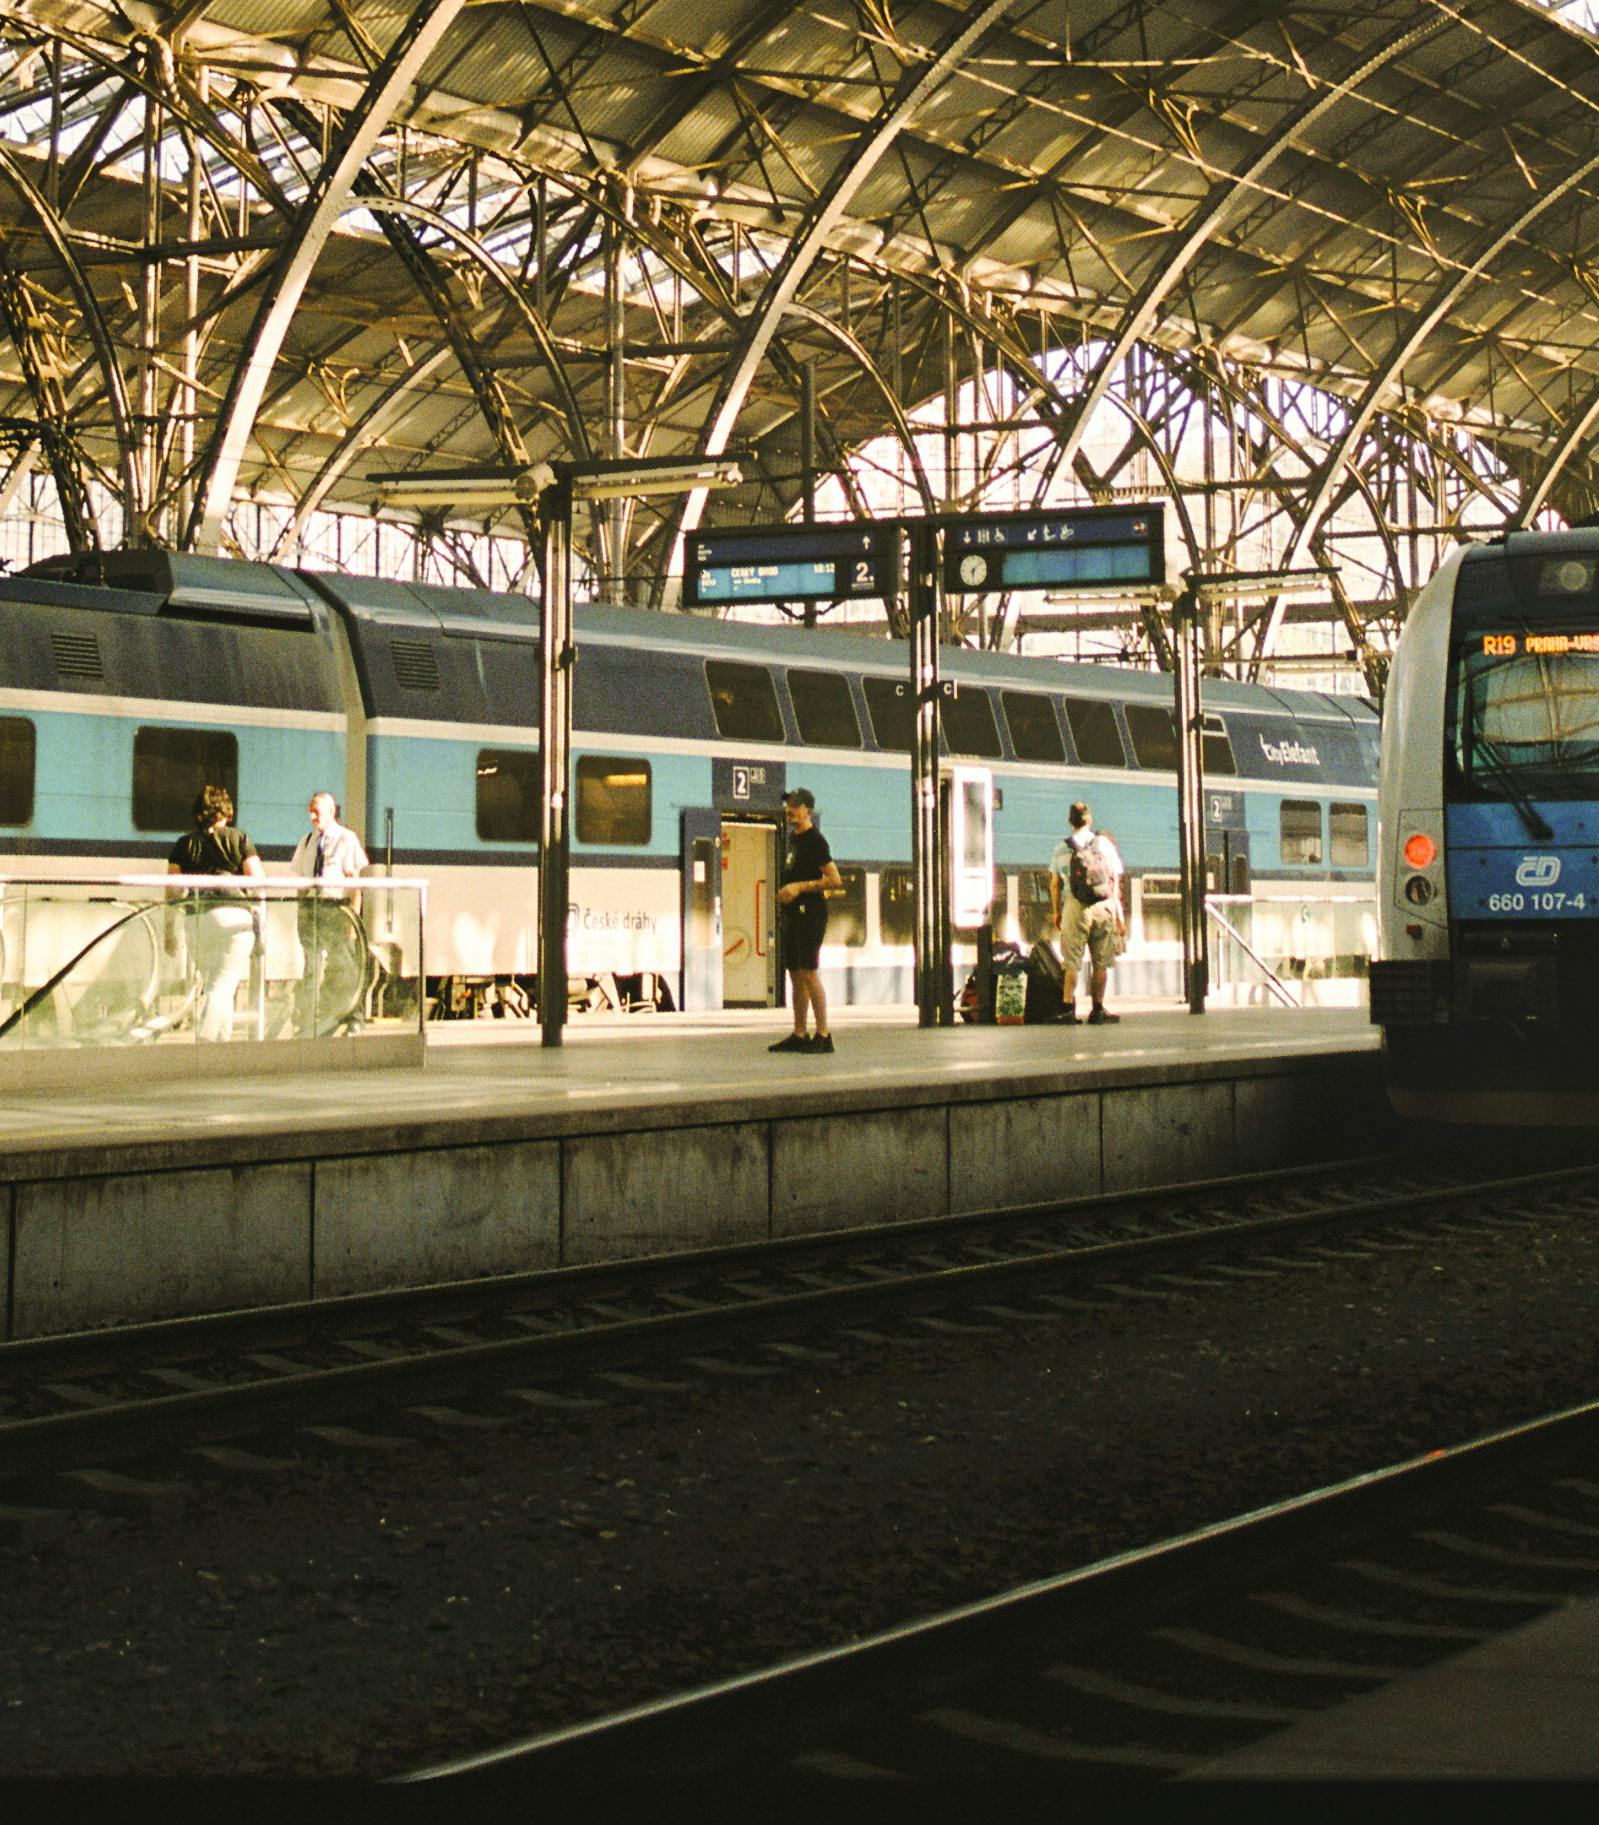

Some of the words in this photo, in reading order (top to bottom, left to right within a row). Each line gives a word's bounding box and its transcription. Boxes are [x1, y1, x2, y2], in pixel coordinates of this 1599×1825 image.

[1483, 635, 1516, 656] R19
[895, 684, 905, 696] C
[943, 683, 953, 695] C
[737, 771, 747, 794] 2
[1213, 800, 1220, 818] 2
[1489, 893, 1525, 911] 660
[1531, 892, 1586, 910] 107-4
[583, 907, 619, 930] České
[623, 910, 657, 935] dráhy
